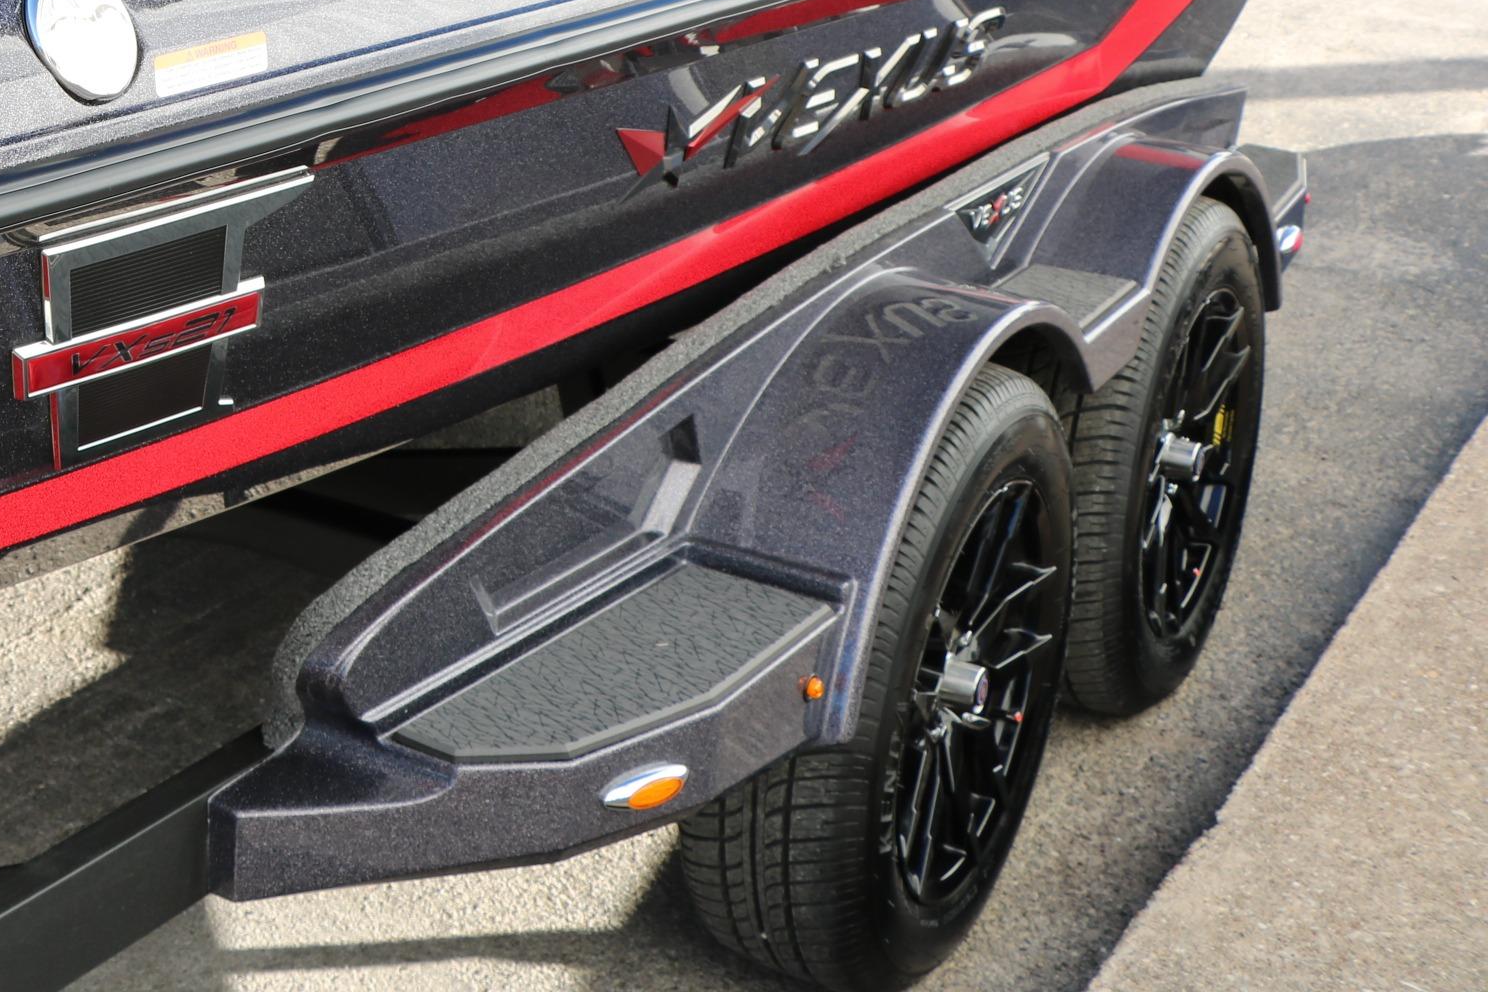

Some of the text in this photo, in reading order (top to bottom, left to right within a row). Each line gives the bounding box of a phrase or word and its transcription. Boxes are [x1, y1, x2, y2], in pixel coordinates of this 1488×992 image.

[194, 40, 237, 58] WARNING
[616, 7, 1006, 205] VEXUS
[969, 186, 1023, 229] VEXUS
